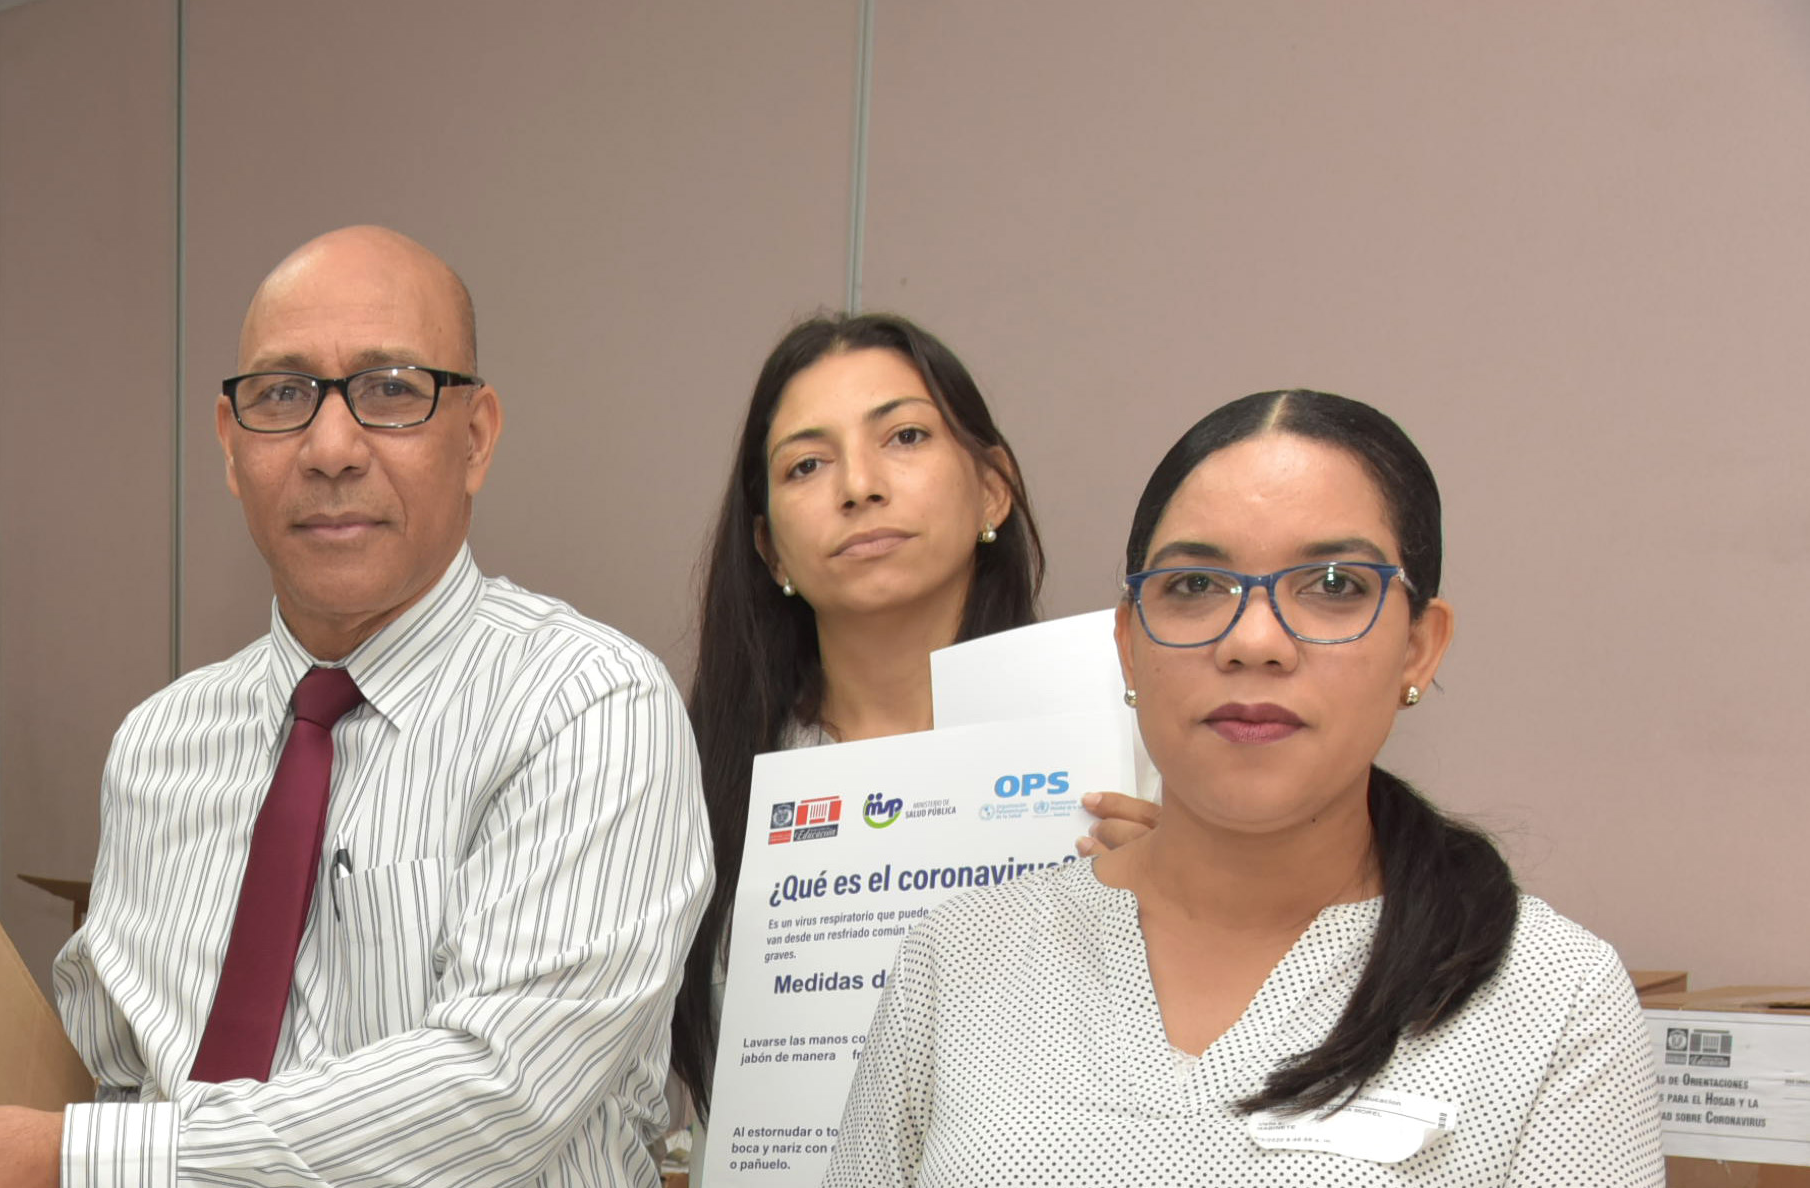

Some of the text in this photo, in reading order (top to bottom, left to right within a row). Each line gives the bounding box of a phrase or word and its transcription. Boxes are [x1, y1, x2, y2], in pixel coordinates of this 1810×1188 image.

[994, 771, 1069, 798] OPS
[905, 806, 957, 819] SALUD PÚBLICA
[769, 870, 827, 907] ¿Qué
[833, 873, 861, 895] es
[868, 864, 891, 892] el
[768, 907, 929, 930] Es un virus respiratorio que puede
[767, 924, 905, 945] van desde un resfriado común
[764, 951, 797, 964] graves.
[774, 969, 888, 994] Medidas d
[743, 1035, 866, 1048] Lavarse las manos co
[740, 1051, 836, 1066] jabón de manera
[1668, 1076, 1679, 1085] DE
[1682, 1073, 1749, 1090] ORIENTACIONES
[1667, 1093, 1689, 1103] PARA
[1692, 1095, 1702, 1105] EL
[1705, 1092, 1736, 1107] HOGAR
[1739, 1098, 1744, 1108] Y
[1748, 1098, 1759, 1109] LA
[1675, 1111, 1702, 1124] SOBRE
[1705, 1111, 1766, 1128] CORONAVIRUS
[733, 1127, 745, 1137] Al
[747, 1126, 812, 1137] estornudar
[815, 1129, 823, 1137] o
[731, 1143, 828, 1156] boca y nariz con
[729, 1158, 791, 1172] o pañuelo.
